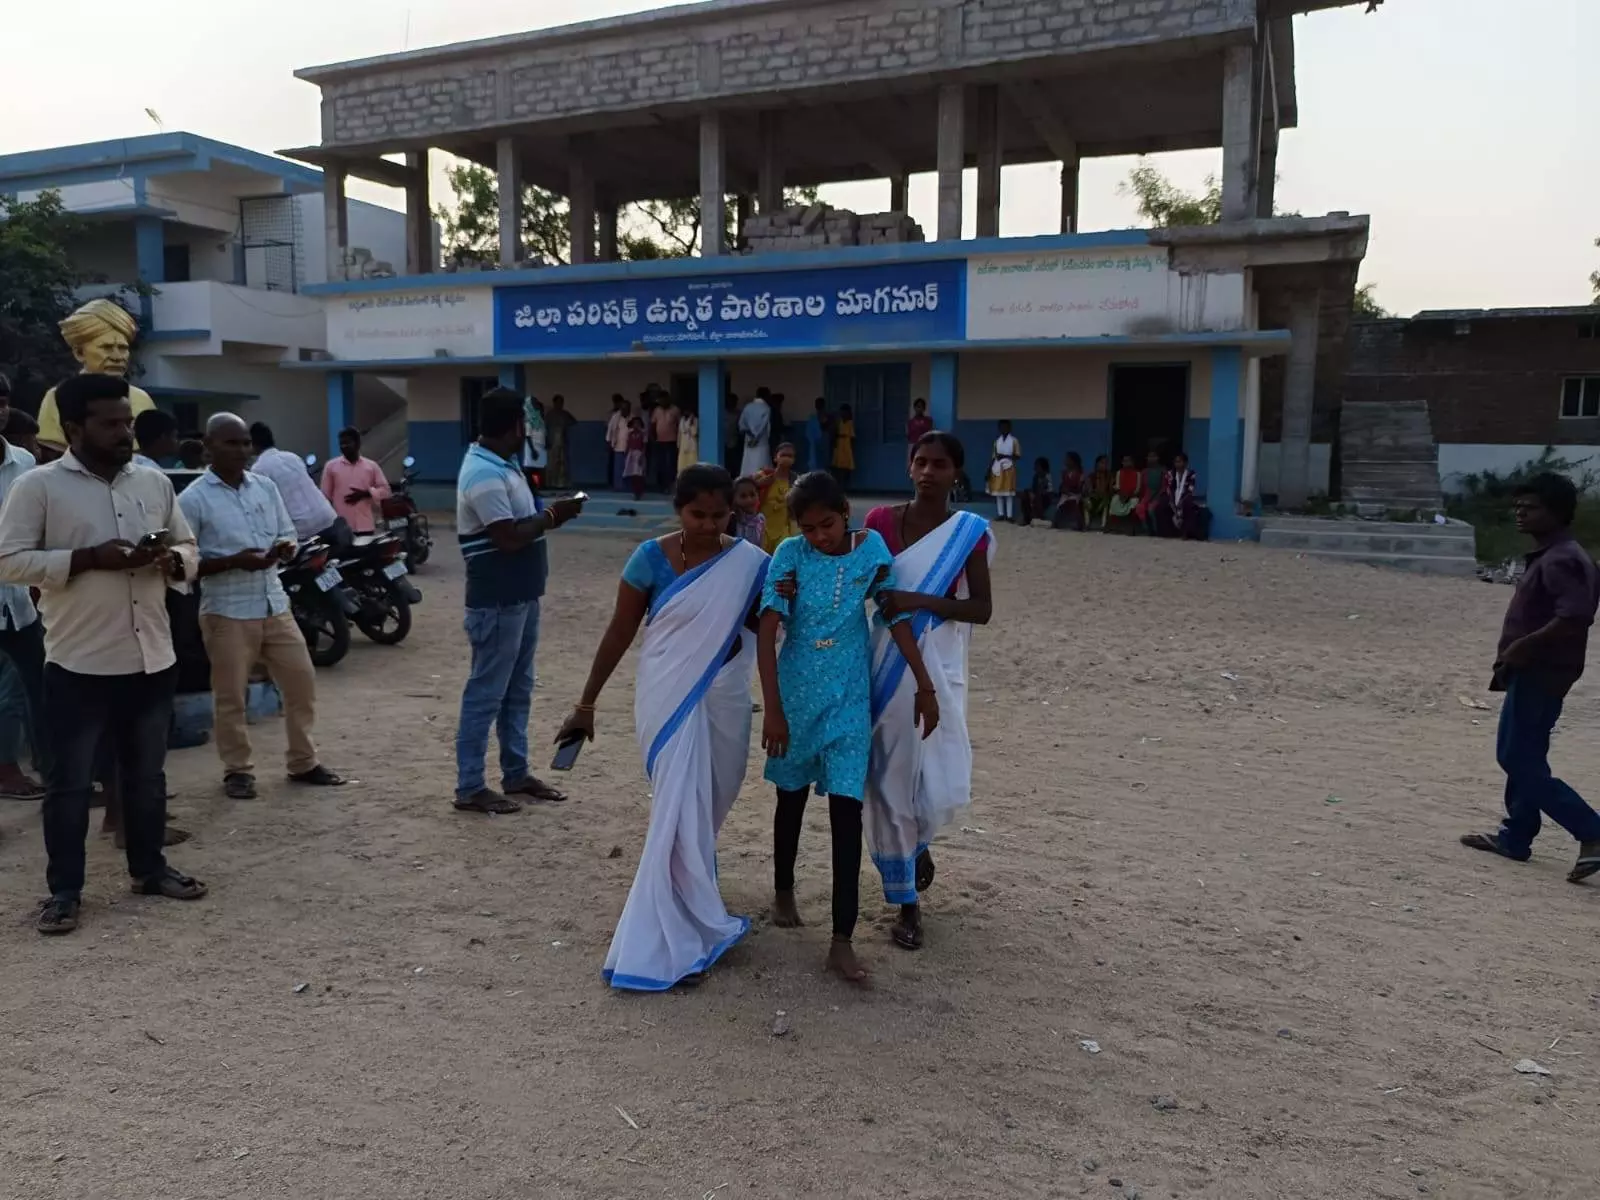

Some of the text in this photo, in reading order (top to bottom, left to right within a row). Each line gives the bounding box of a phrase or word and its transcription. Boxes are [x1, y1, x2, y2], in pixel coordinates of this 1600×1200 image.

[514, 283, 939, 333] జిల్లా పరిషత్ ఉన్నత పాఠశాల మాగనూర్
